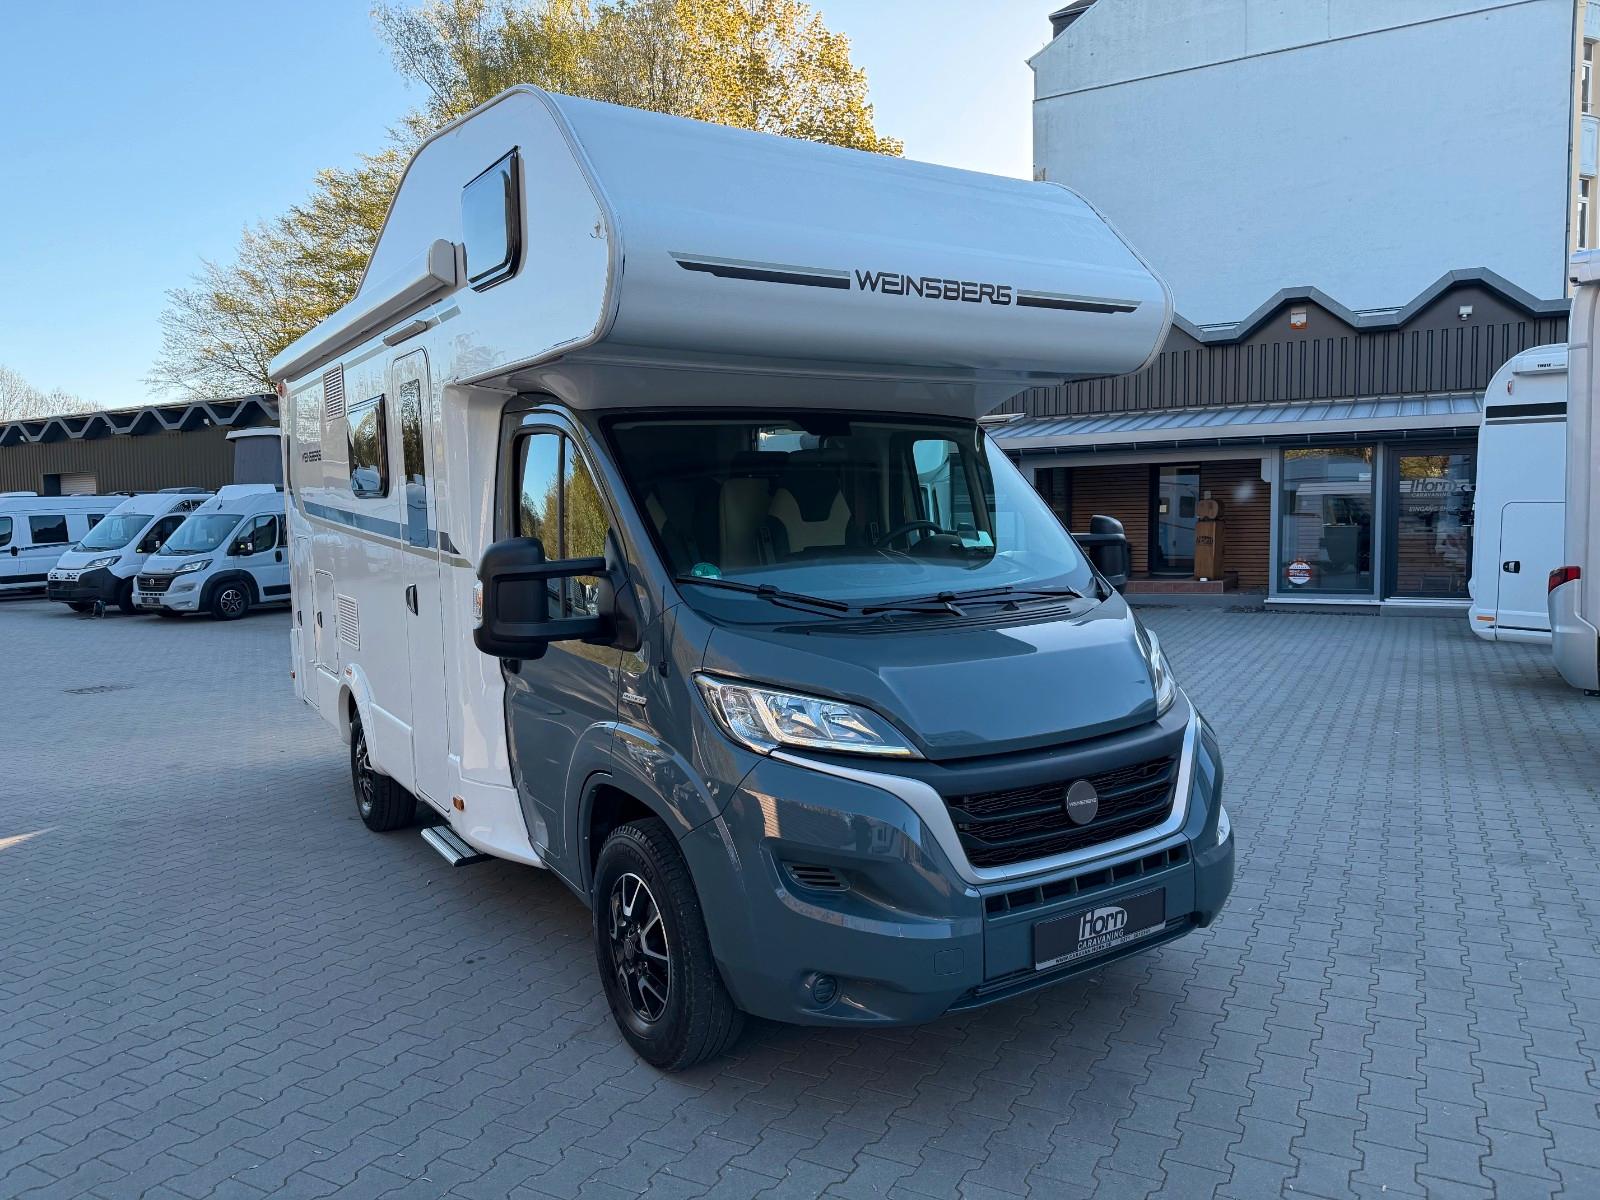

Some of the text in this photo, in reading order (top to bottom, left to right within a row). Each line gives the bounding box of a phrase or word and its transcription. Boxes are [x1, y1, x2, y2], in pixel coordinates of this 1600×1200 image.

[854, 269, 1013, 306] WEINSBERG
[1080, 907, 1127, 940] Horn
[1077, 929, 1125, 952] CARAVANING
